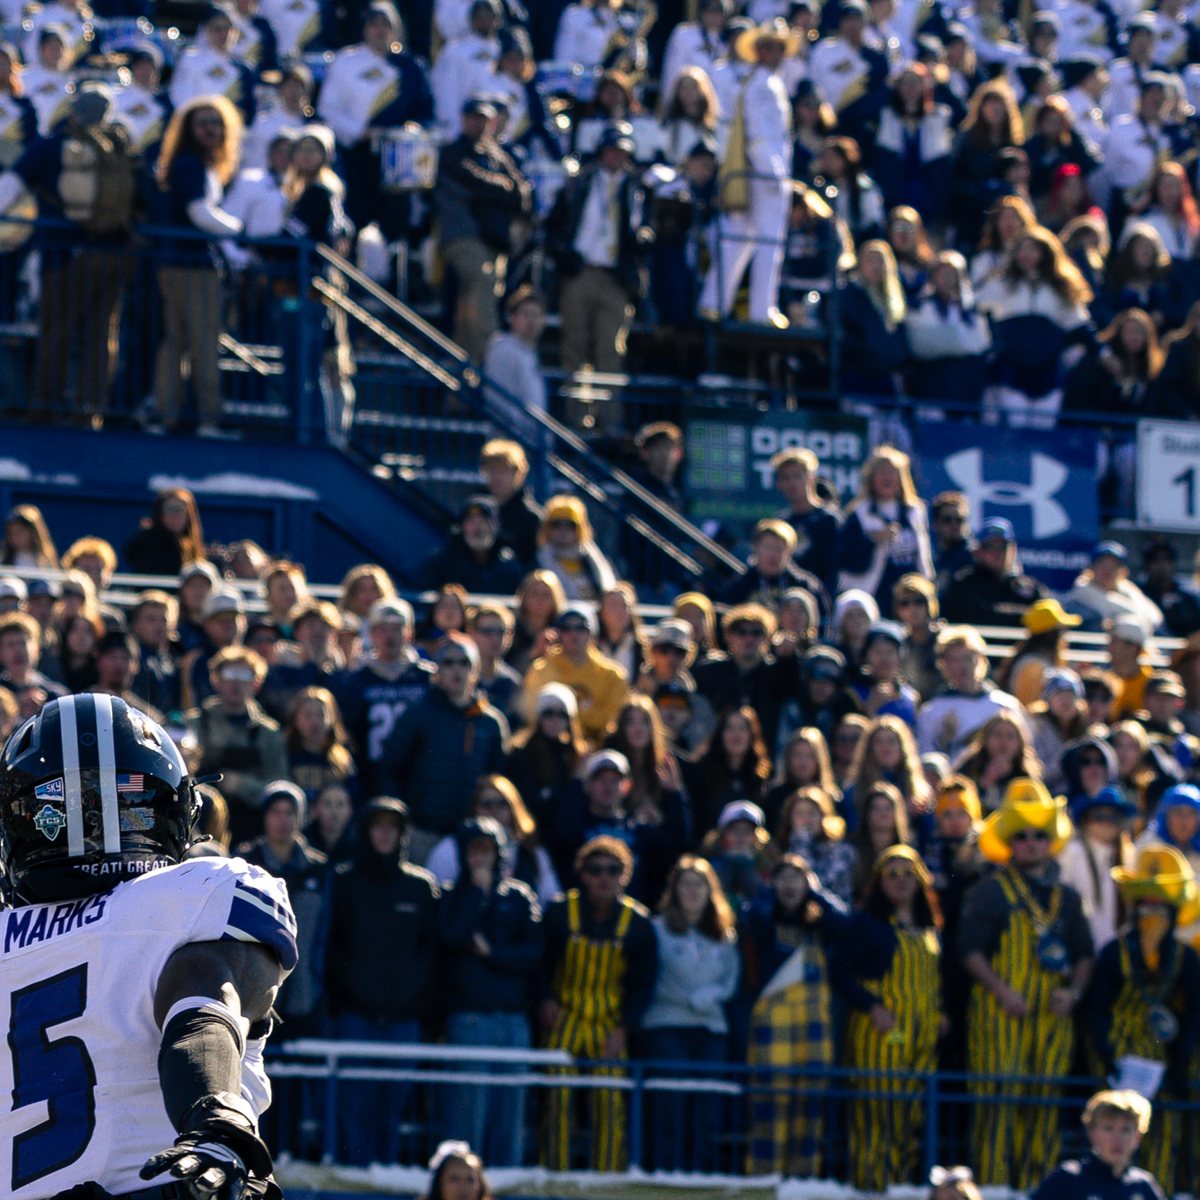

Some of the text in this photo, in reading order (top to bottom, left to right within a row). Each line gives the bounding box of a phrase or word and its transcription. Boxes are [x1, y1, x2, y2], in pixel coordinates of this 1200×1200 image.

[752, 425, 860, 462] DOOR
[46, 781, 61, 793] SKY
[73, 861, 122, 876] REAT!
[4, 889, 114, 954] MARKS
[7, 962, 97, 1192] 5
